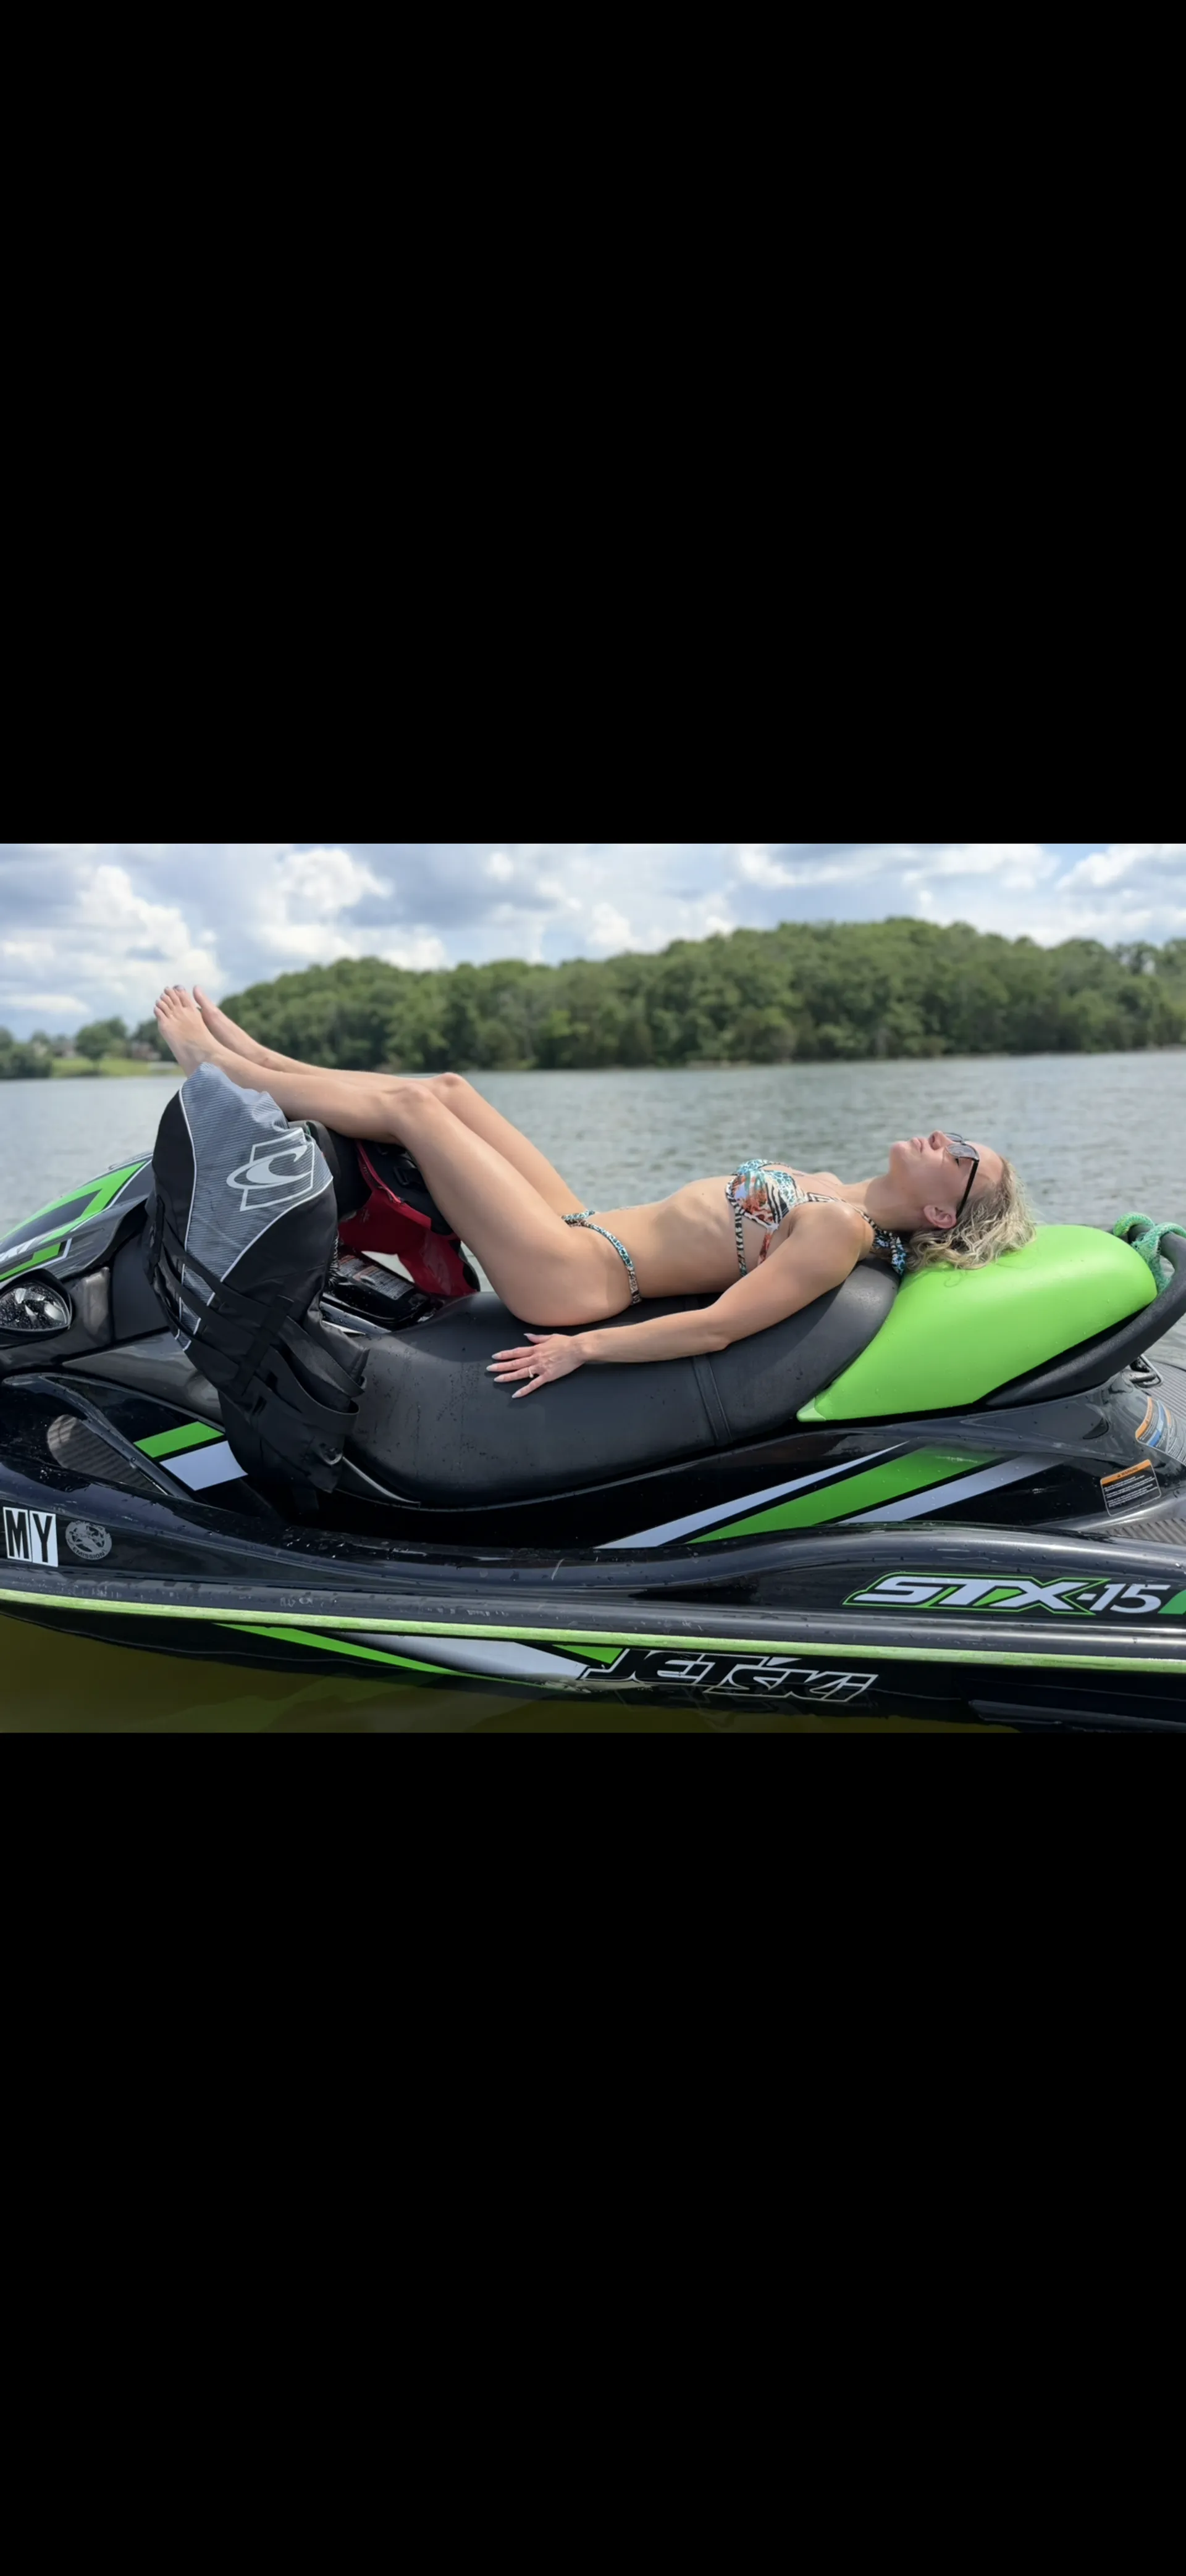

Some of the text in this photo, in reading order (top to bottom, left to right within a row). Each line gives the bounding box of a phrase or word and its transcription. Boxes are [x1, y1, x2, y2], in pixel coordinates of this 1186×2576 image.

[5, 1510, 53, 1563] MY
[853, 1576, 1171, 1614] STX-15
[579, 1648, 770, 1689] JET
